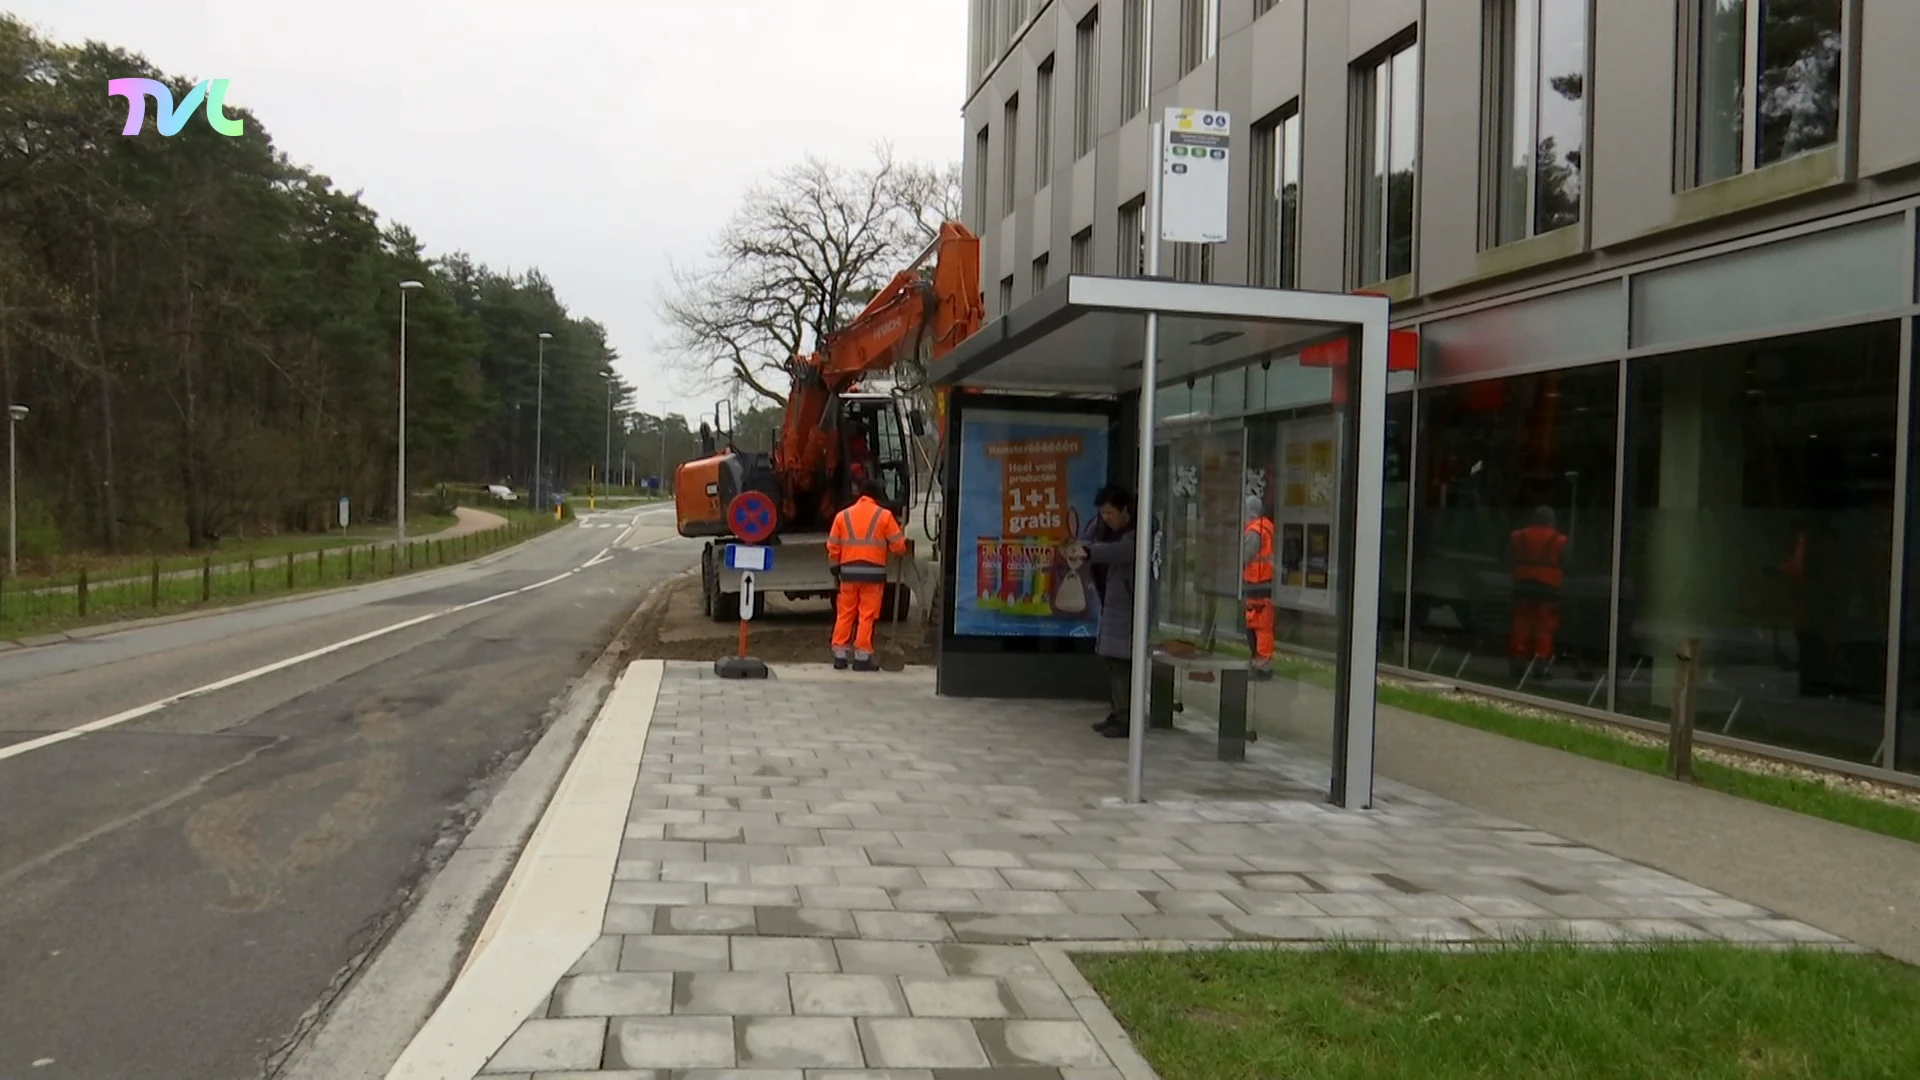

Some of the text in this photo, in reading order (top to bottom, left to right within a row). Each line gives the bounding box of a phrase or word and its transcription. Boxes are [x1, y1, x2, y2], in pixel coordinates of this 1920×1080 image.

[1008, 460, 1057, 473] Heel veel
[1008, 473, 1057, 485] producten
[1009, 487, 1060, 512] 1+1
[1009, 511, 1061, 534] gratis
